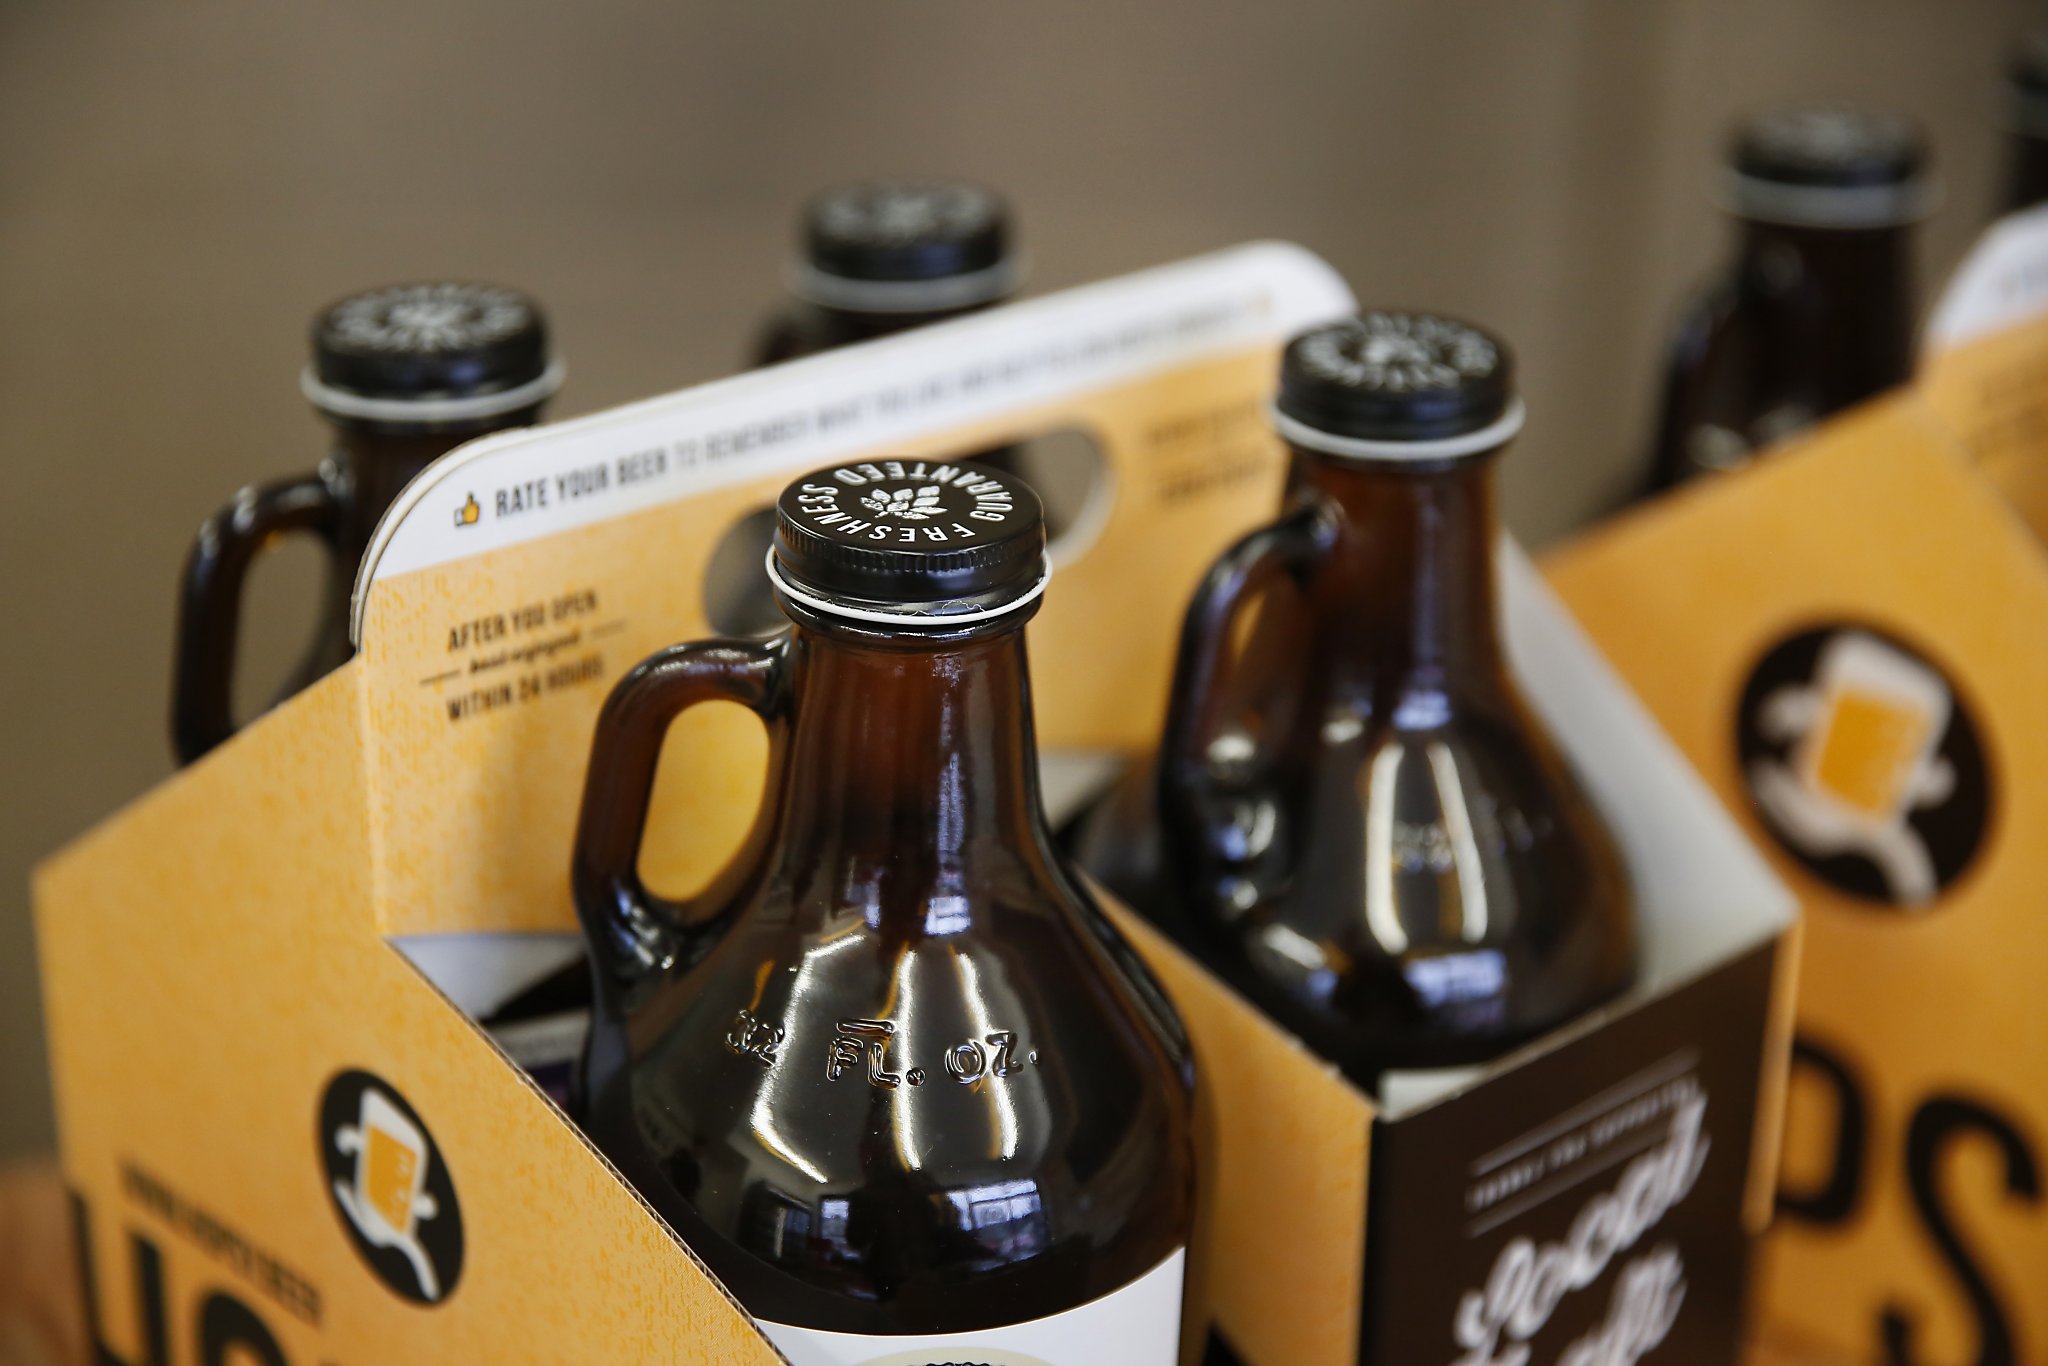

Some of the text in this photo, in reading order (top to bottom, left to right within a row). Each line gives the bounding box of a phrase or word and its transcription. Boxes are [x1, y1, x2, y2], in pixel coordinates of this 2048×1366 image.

[495, 471, 547, 518] RATE
[555, 461, 610, 501] YOUR
[617, 445, 667, 487] BEER
[798, 460, 1014, 543] FRESHNESS GUARANTEED
[447, 587, 598, 653] AFTER YOU OPEN
[446, 682, 513, 721] WITHIN
[547, 656, 604, 694] HOURS
